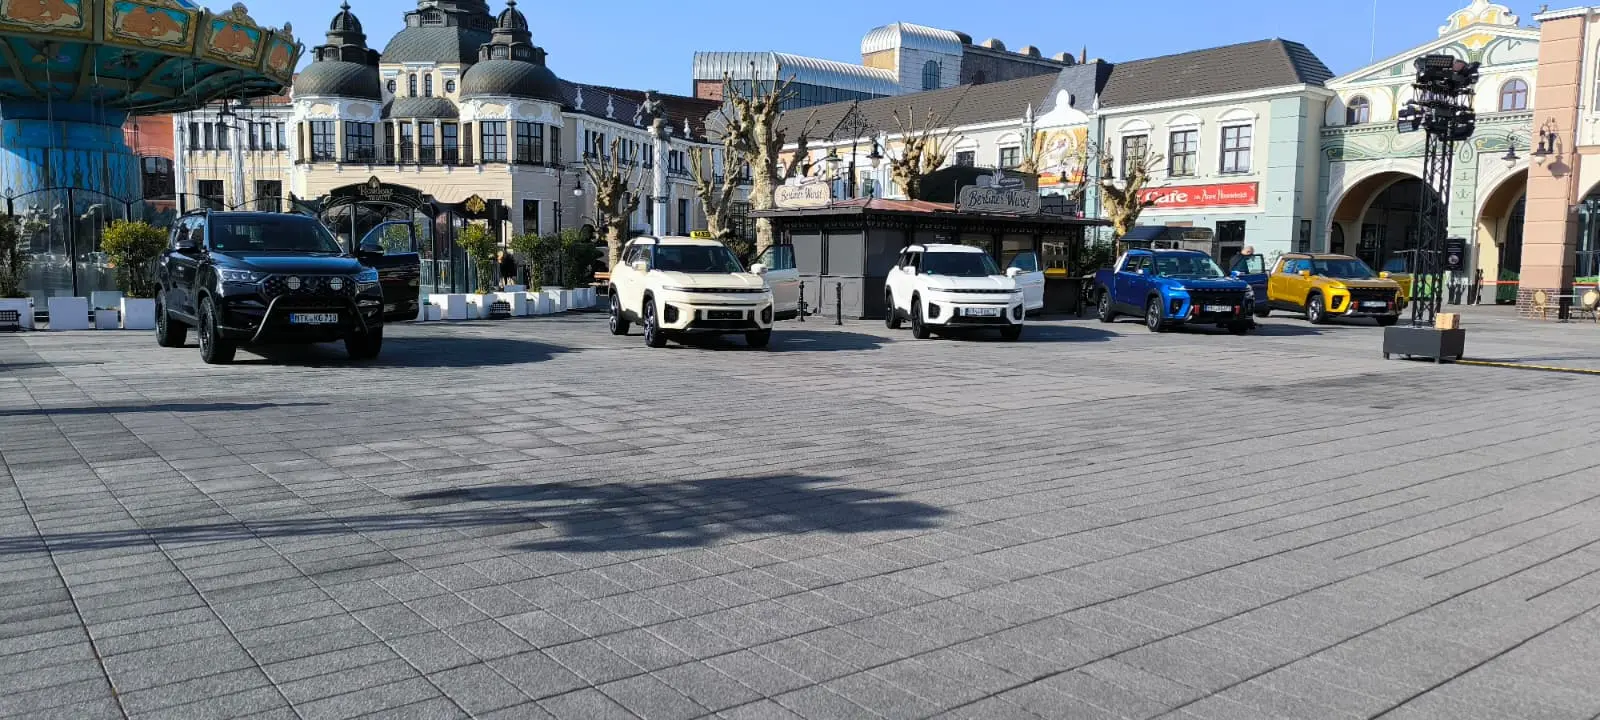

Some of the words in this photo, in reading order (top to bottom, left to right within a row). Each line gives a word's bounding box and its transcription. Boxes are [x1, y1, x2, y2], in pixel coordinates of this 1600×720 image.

[804, 187, 823, 200] Wurst
[968, 190, 1004, 207] Berliner
[1005, 190, 1031, 208] Wurst
